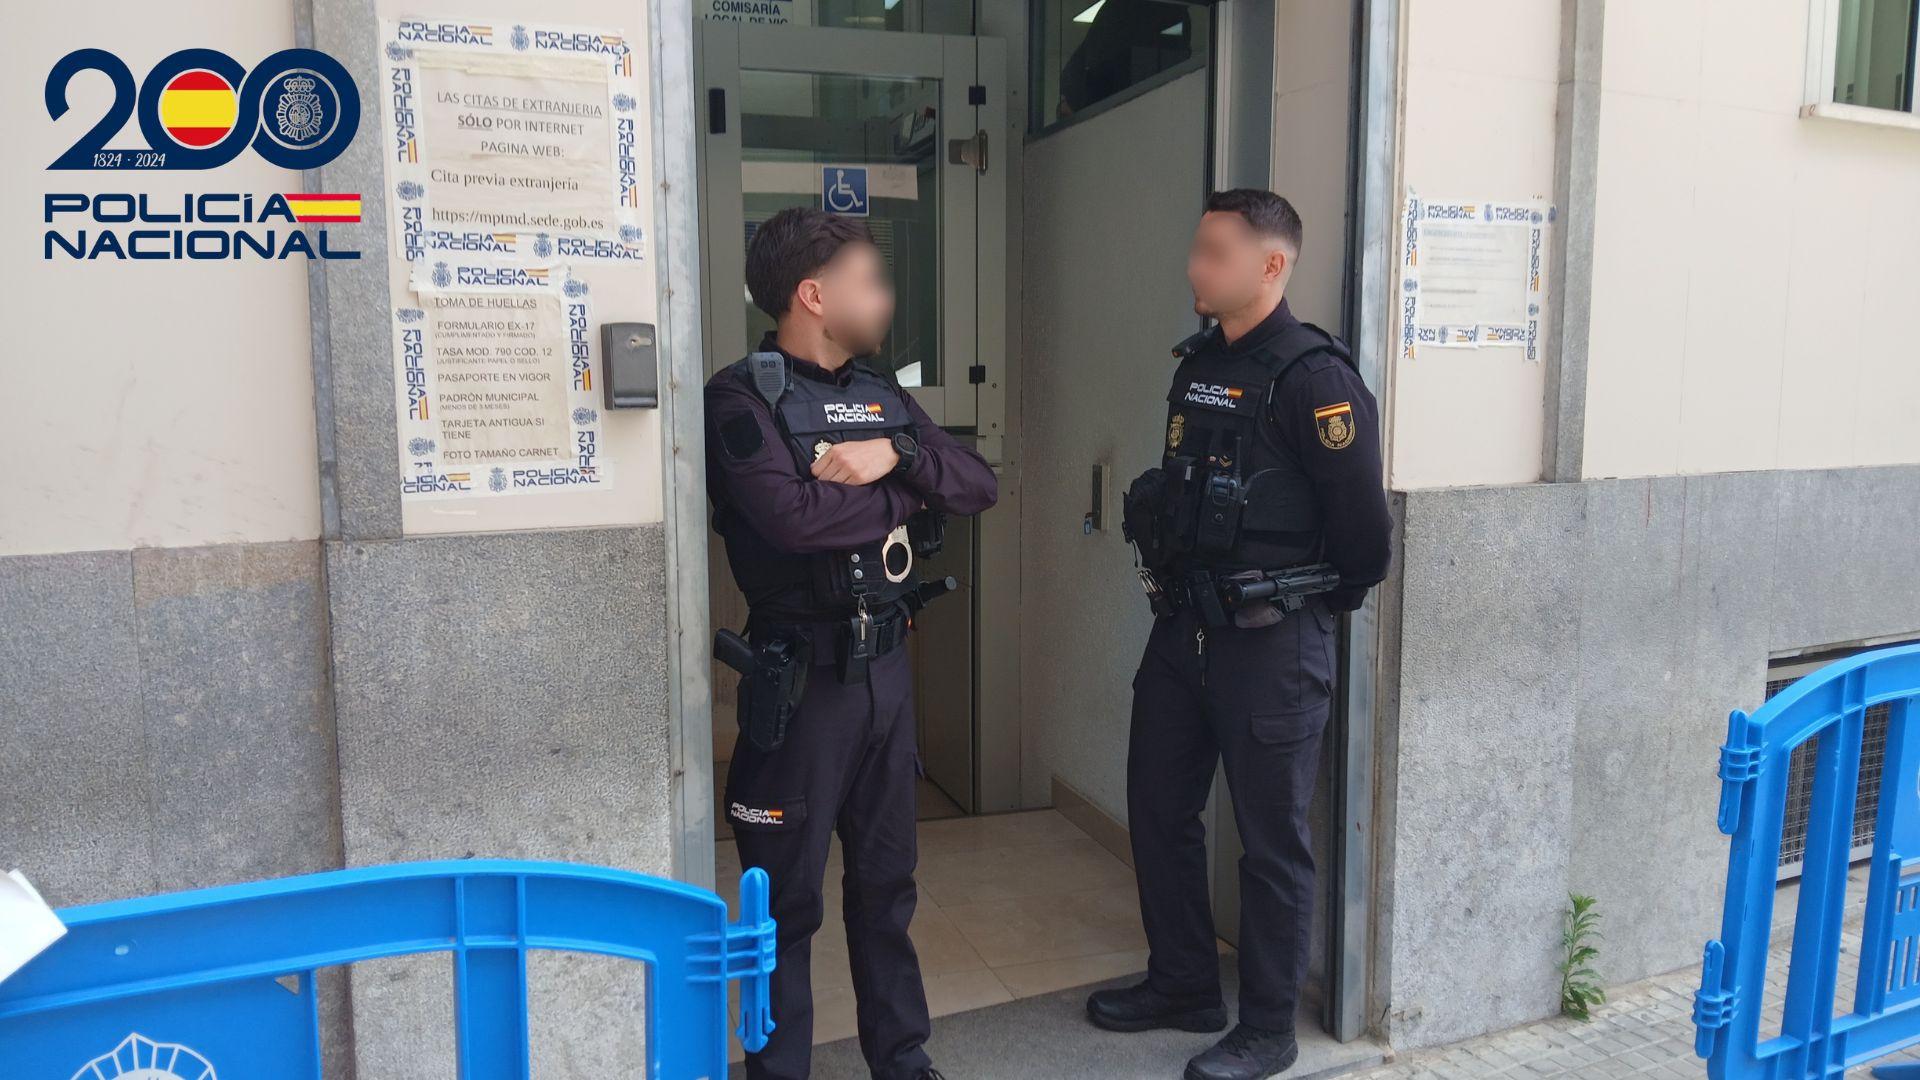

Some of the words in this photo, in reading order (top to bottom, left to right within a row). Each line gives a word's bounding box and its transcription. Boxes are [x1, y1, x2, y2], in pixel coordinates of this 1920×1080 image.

[398, 31, 492, 46] NACIONAL
[535, 40, 620, 55] NACIONAL
[437, 91, 460, 104] LAS
[464, 93, 498, 108] CITAS
[503, 97, 518, 110] DE
[391, 67, 406, 163] NACIONAL
[458, 113, 492, 129] SÓLO
[497, 117, 521, 131] POR
[525, 121, 585, 135] INTERNET
[532, 146, 565, 158] WEB:
[617, 118, 628, 207] NACIONAL
[431, 169, 459, 184] Cita
[464, 173, 506, 187] previa
[510, 175, 579, 192] extranjería
[432, 207, 604, 231] https://mptmd.sede.gob.es
[1428, 211, 1475, 220] NACIONAL
[558, 247, 643, 260] NACIONAL
[458, 276, 549, 286] NACIONAL
[434, 298, 466, 308] TOMA
[468, 298, 483, 308] DE
[487, 298, 537, 309] HUELLAS
[437, 321, 504, 331] FORMULARIO
[508, 321, 535, 331] EX-17
[436, 347, 463, 356] TASA
[495, 347, 511, 356] 790
[514, 347, 539, 357] COD.
[542, 347, 552, 356] 12
[569, 304, 582, 391] NACIONAL
[402, 329, 418, 420] NACIONAL
[437, 373, 500, 382] PASAPORTE
[502, 373, 516, 381] EN
[518, 372, 551, 381] VIGOR
[439, 392, 482, 402] PADRÓN
[485, 392, 540, 401] MUNICIPAL
[1184, 392, 1236, 408] NACIONAL
[441, 419, 486, 428] TARJETA
[489, 418, 533, 427] ANTIGUA
[535, 418, 545, 426] SI
[826, 412, 884, 423] NACIONAL
[442, 430, 471, 439] TIENE
[443, 450, 471, 459] FOTO
[474, 448, 516, 458] TAMAÑO
[519, 447, 559, 457] CARNET
[403, 482, 471, 494] CIONAL
[514, 475, 600, 488] NACIONAL
[730, 810, 783, 824] NACIONAL
